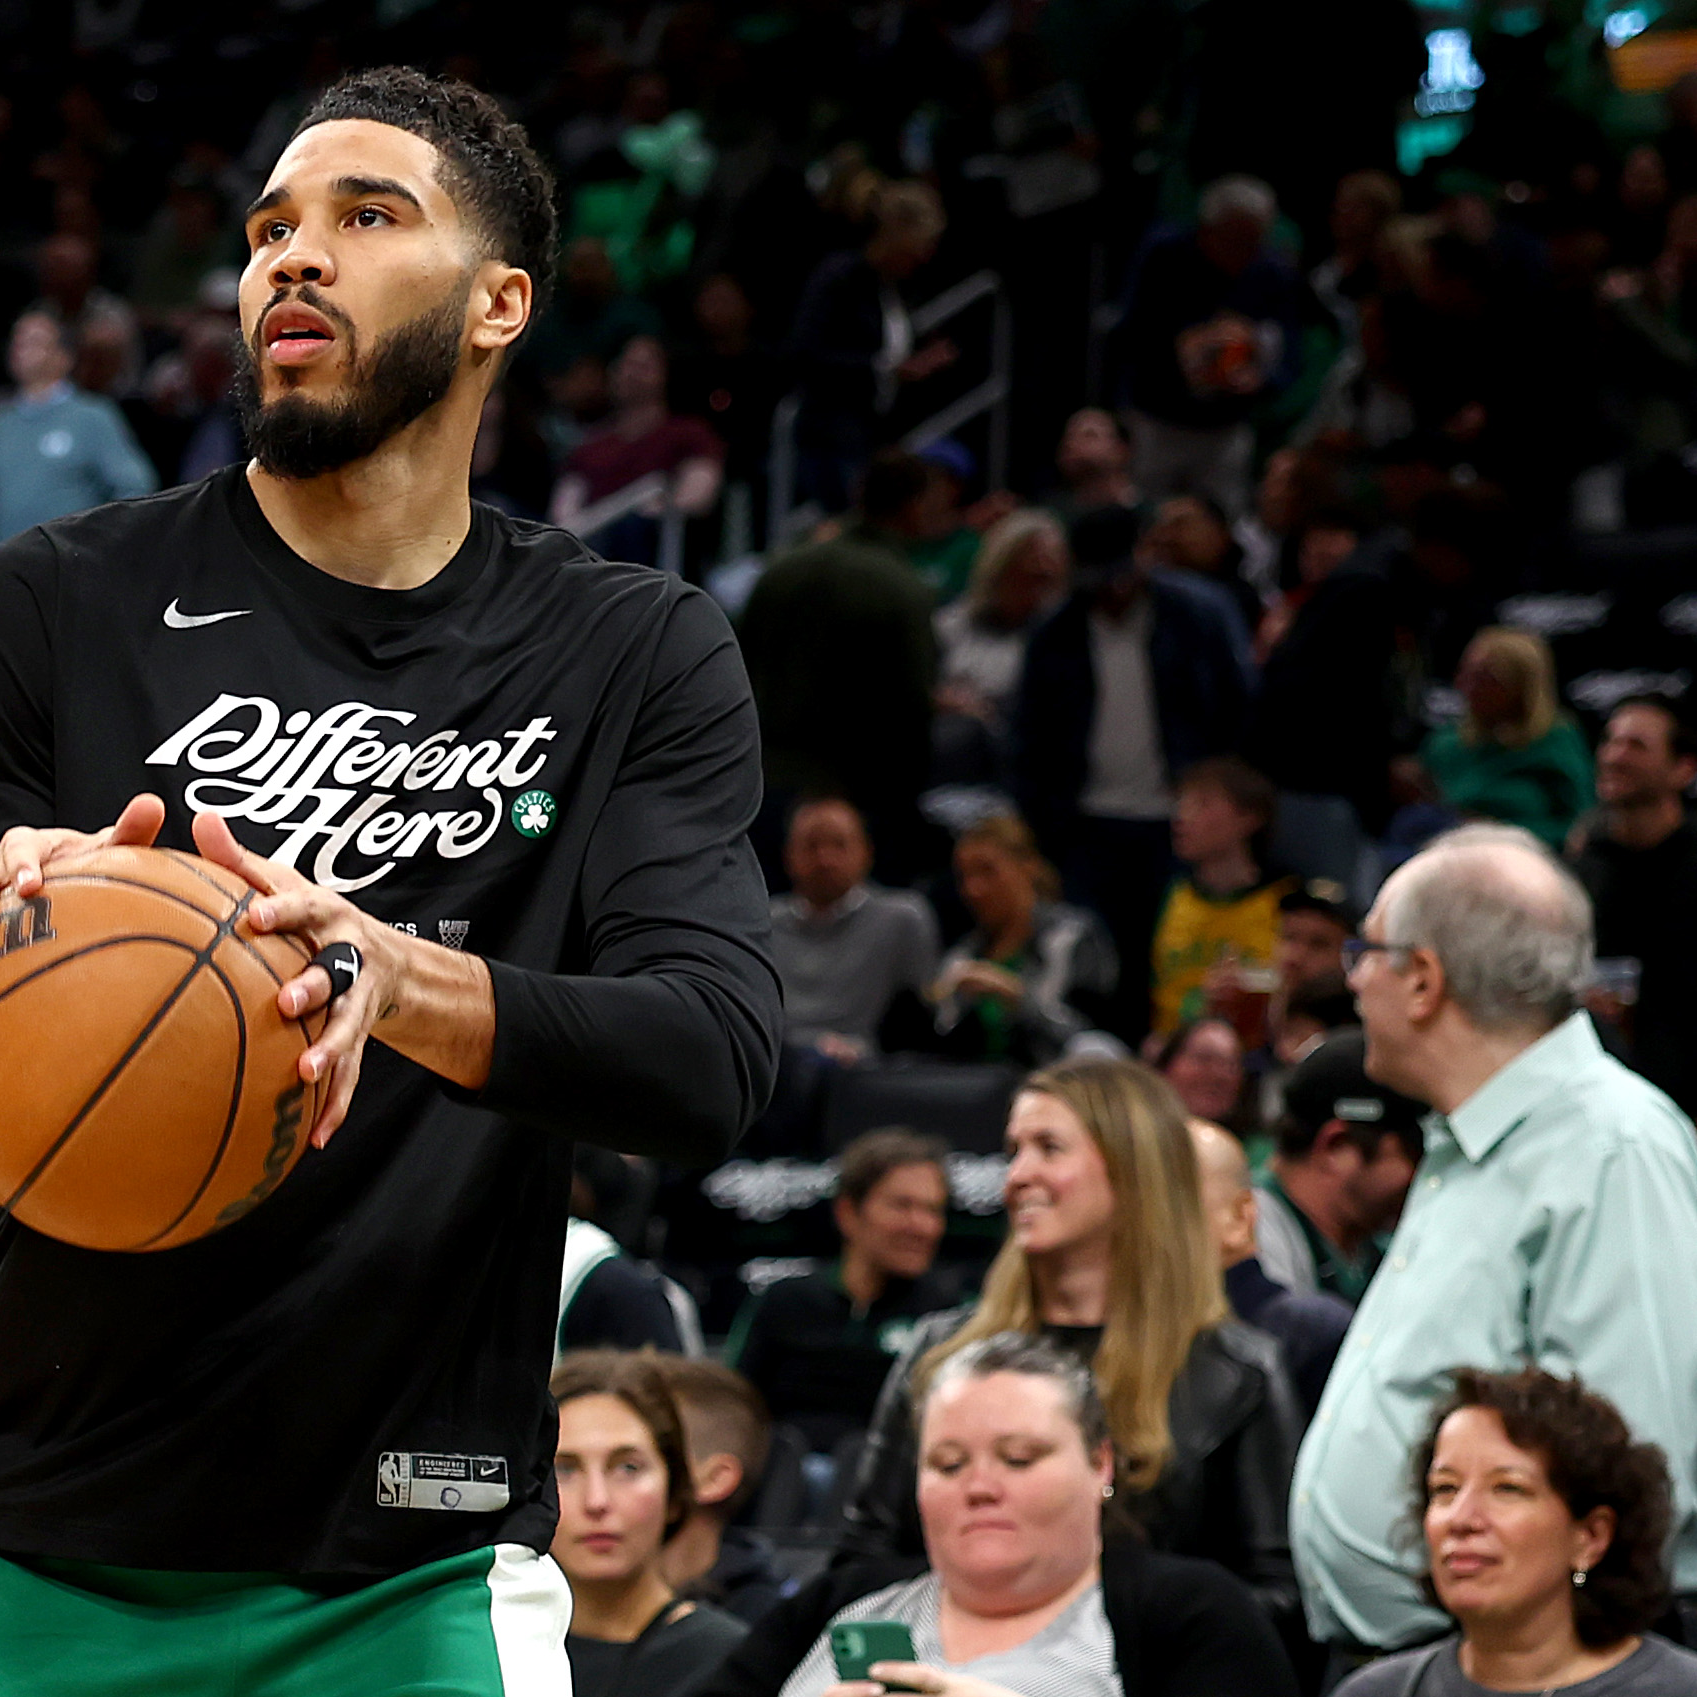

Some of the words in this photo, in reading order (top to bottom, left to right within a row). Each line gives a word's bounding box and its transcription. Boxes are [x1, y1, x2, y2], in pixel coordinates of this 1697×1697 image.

[144, 693, 557, 822] Different
[514, 792, 555, 813] CELTICS
[266, 787, 503, 893] Here
[418, 1458, 466, 1469] ENGINEERED
